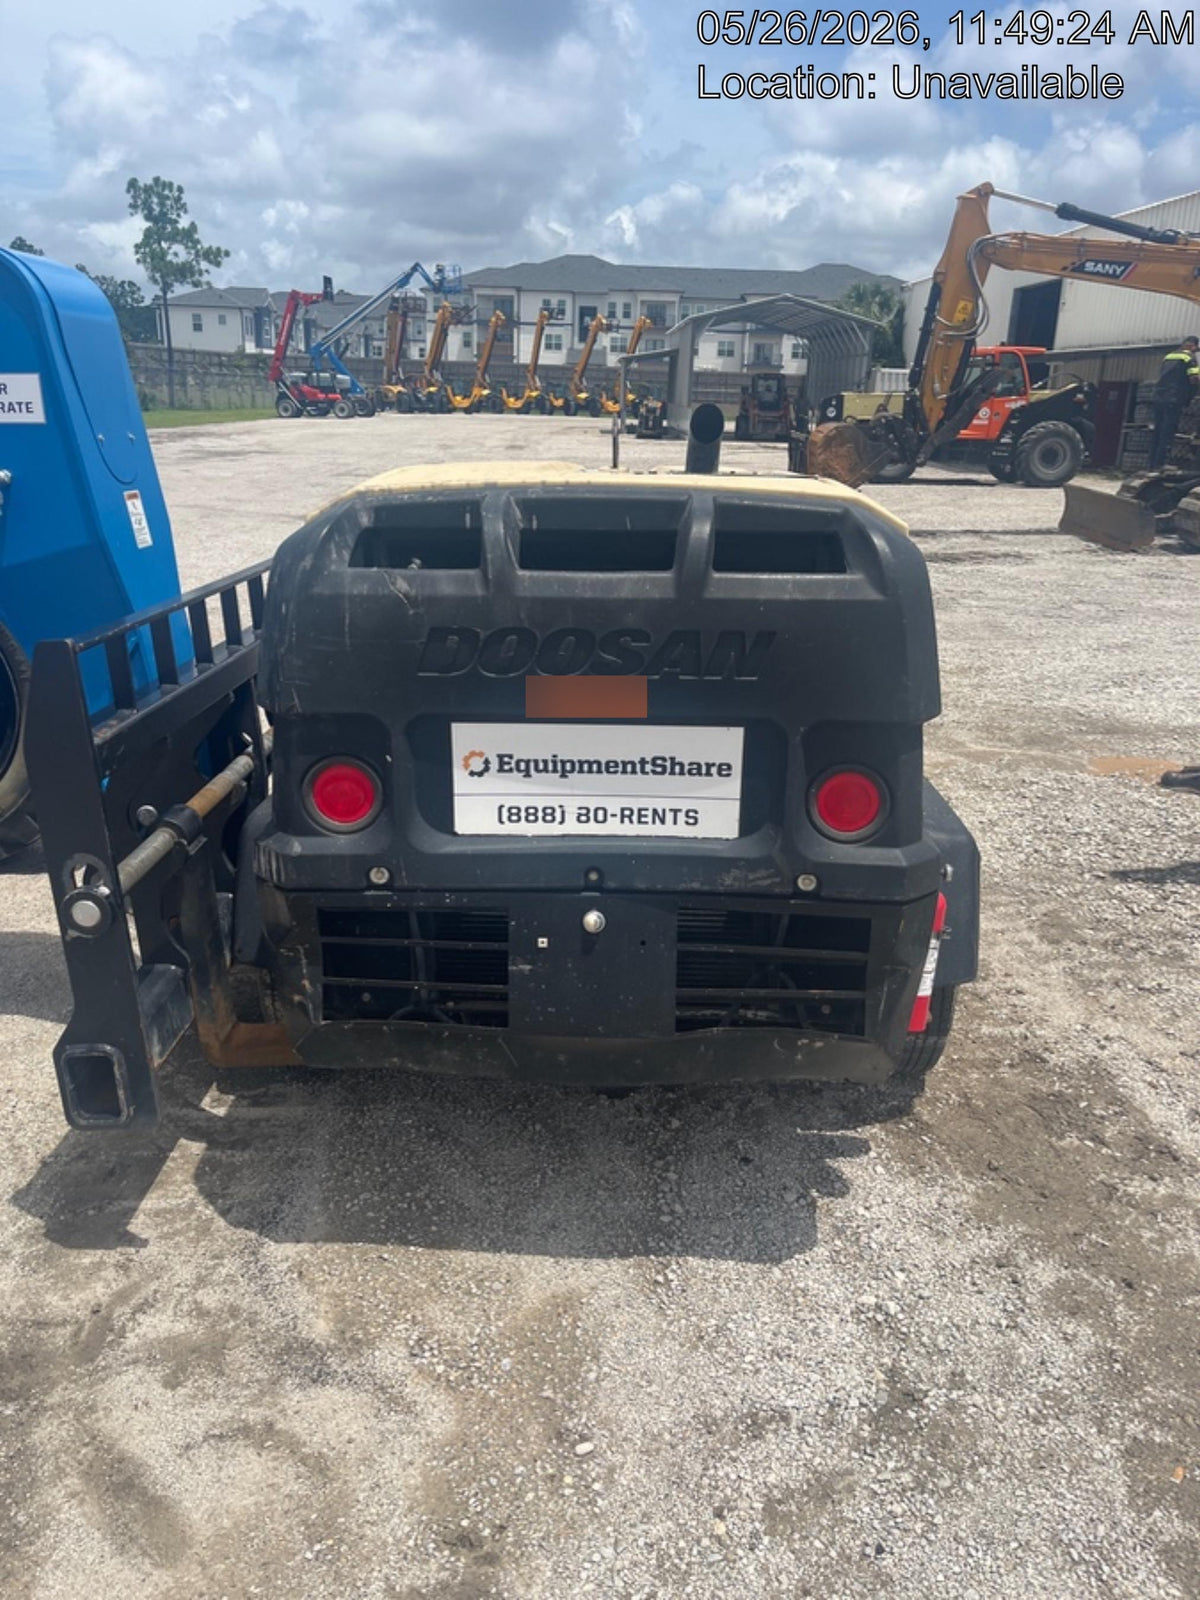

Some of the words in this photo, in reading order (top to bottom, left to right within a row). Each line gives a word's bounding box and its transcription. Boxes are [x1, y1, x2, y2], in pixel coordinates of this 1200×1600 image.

[1084, 261, 1124, 275] SANY
[416, 625, 777, 680] DOOSAN
[496, 753, 733, 779] EquipmentShare
[497, 804, 566, 826] (888)
